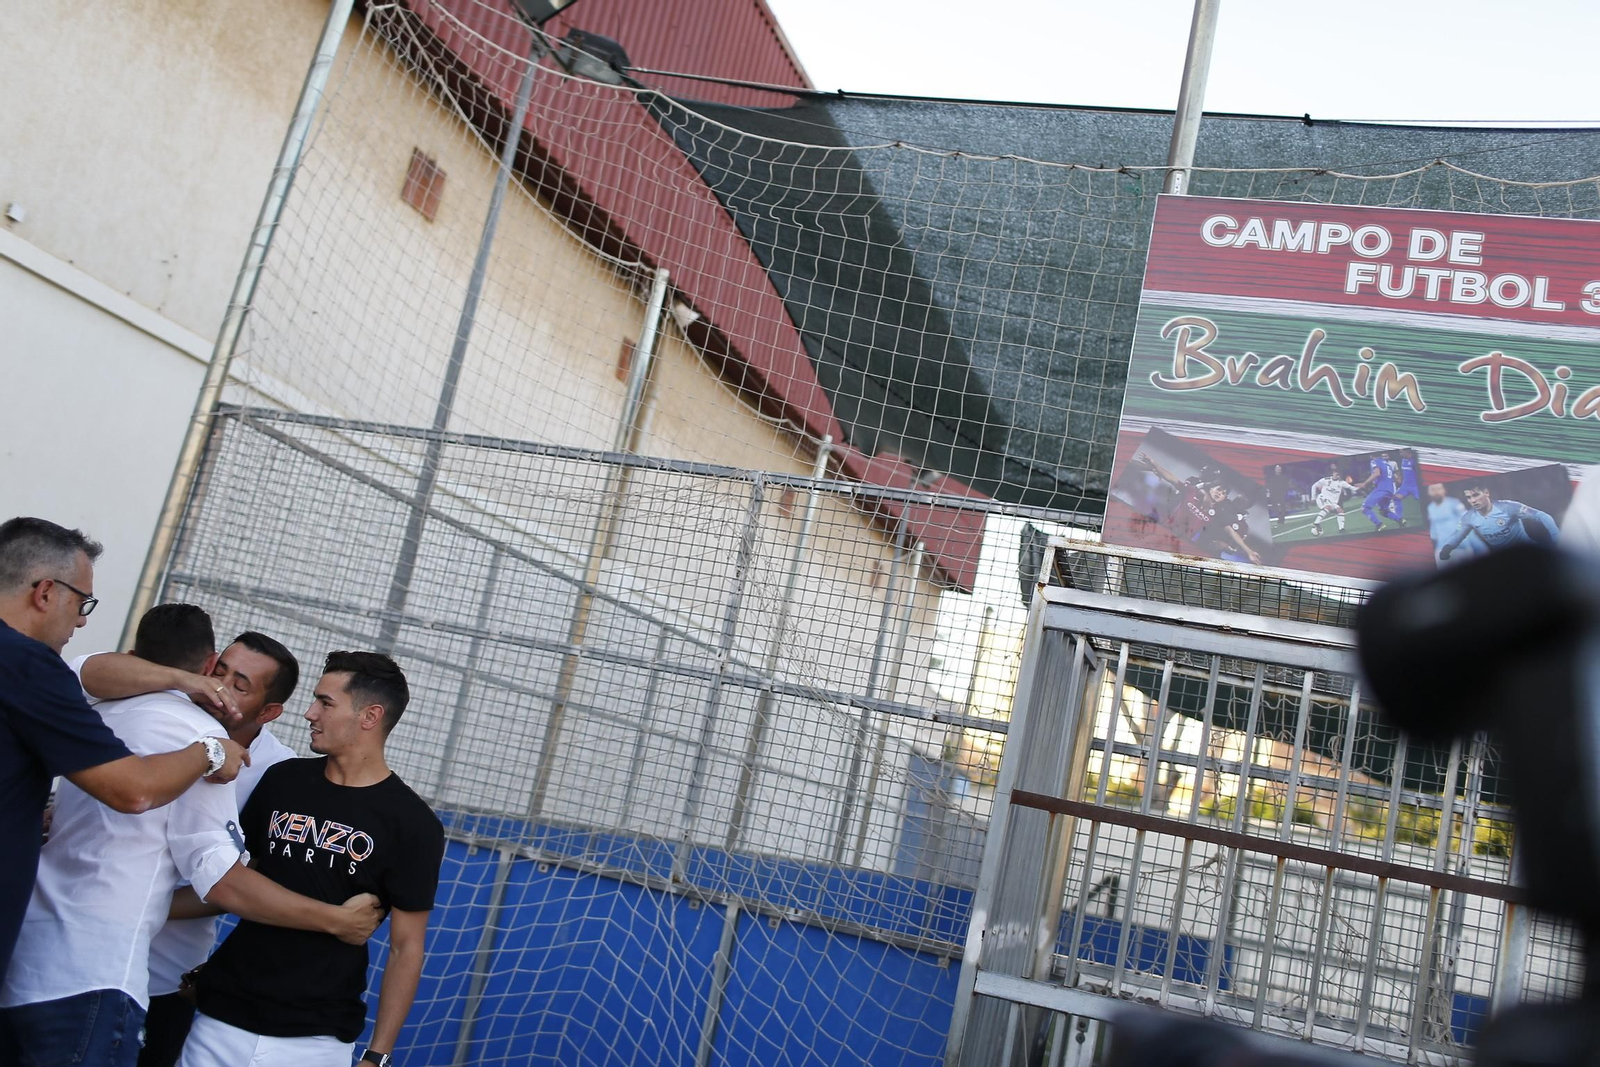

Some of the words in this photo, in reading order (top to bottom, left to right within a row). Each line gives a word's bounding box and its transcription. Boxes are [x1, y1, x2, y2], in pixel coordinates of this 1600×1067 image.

[1201, 214, 1391, 257] CAMPO
[1408, 228, 1484, 265] DE
[1345, 262, 1565, 311] FUTBOL
[1151, 316, 1426, 413] Brahim
[268, 810, 374, 861] KENZO
[269, 841, 356, 875] PARIS
